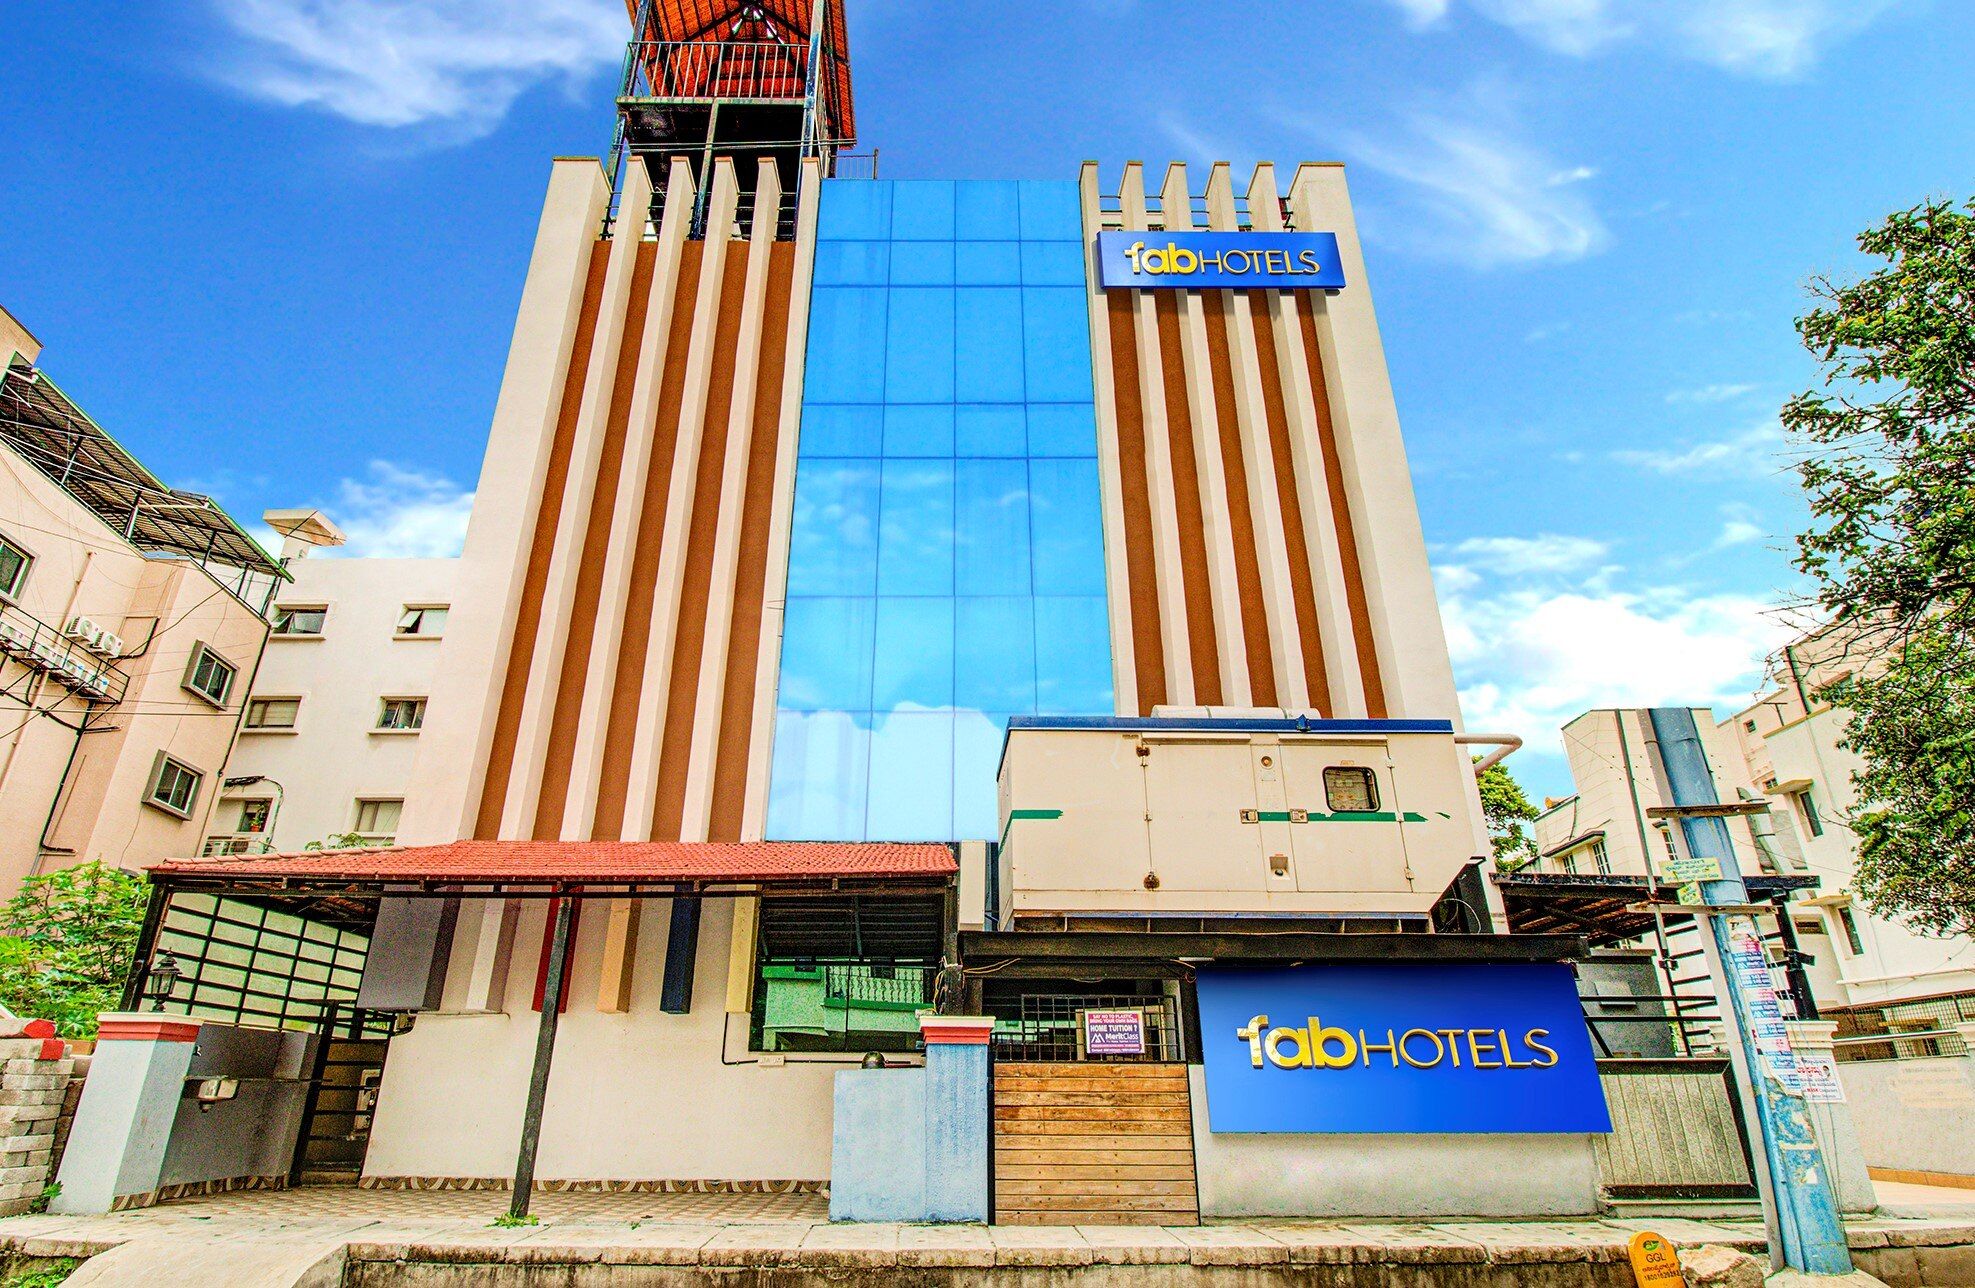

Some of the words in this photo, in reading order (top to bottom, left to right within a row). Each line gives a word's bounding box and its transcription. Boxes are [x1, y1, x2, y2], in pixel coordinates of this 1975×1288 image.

[1090, 1024, 1108, 1032] HOME
[1108, 1024, 1133, 1032] TUITION
[1646, 1252, 1666, 1263] GGL
